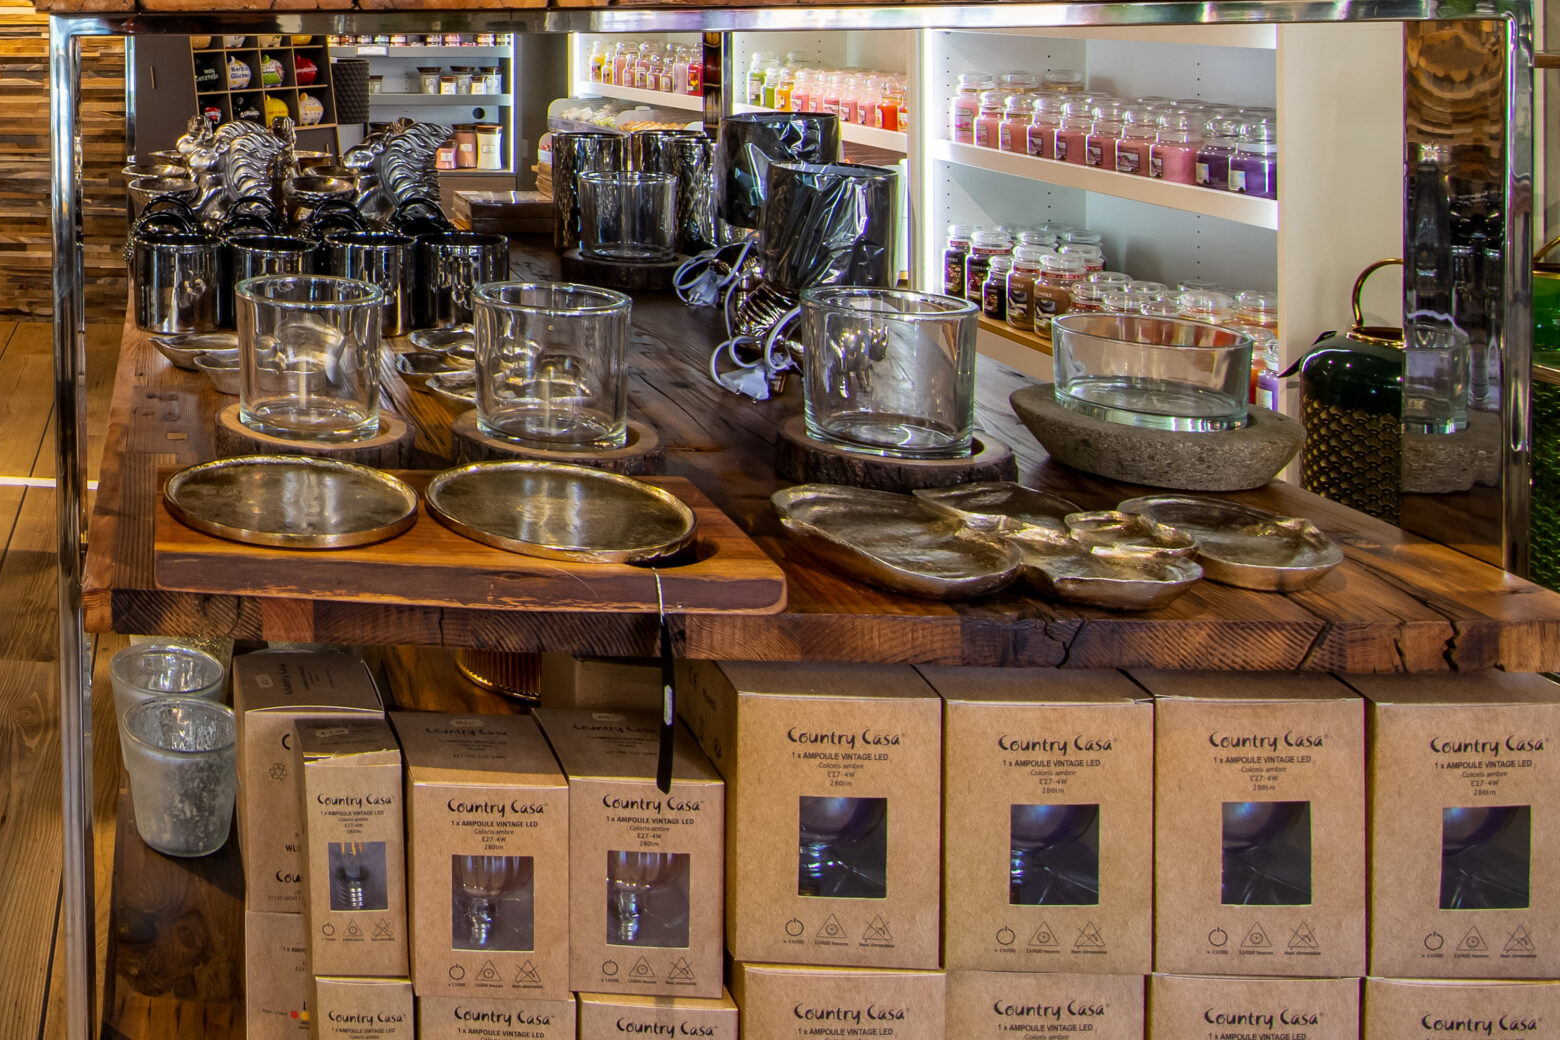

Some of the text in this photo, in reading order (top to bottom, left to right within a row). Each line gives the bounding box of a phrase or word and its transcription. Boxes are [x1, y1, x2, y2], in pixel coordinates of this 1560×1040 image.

[788, 727, 901, 749] Country Casa
[999, 735, 1112, 756] Country Casa
[1209, 731, 1323, 752] Country Casa
[1430, 735, 1544, 757] Country Casa
[317, 793, 391, 808] Country Casa
[447, 799, 544, 817] Country Casa
[603, 794, 700, 814] Country Casa
[328, 1010, 402, 1026] Country Casa
[454, 1006, 550, 1027] Country Casa
[794, 1003, 904, 1024] Country Casa
[994, 1000, 1104, 1020] Country Casa
[1204, 1008, 1318, 1029] Country Casa
[616, 1018, 713, 1039] Country Casa
[1422, 1014, 1537, 1036] Country Casa
